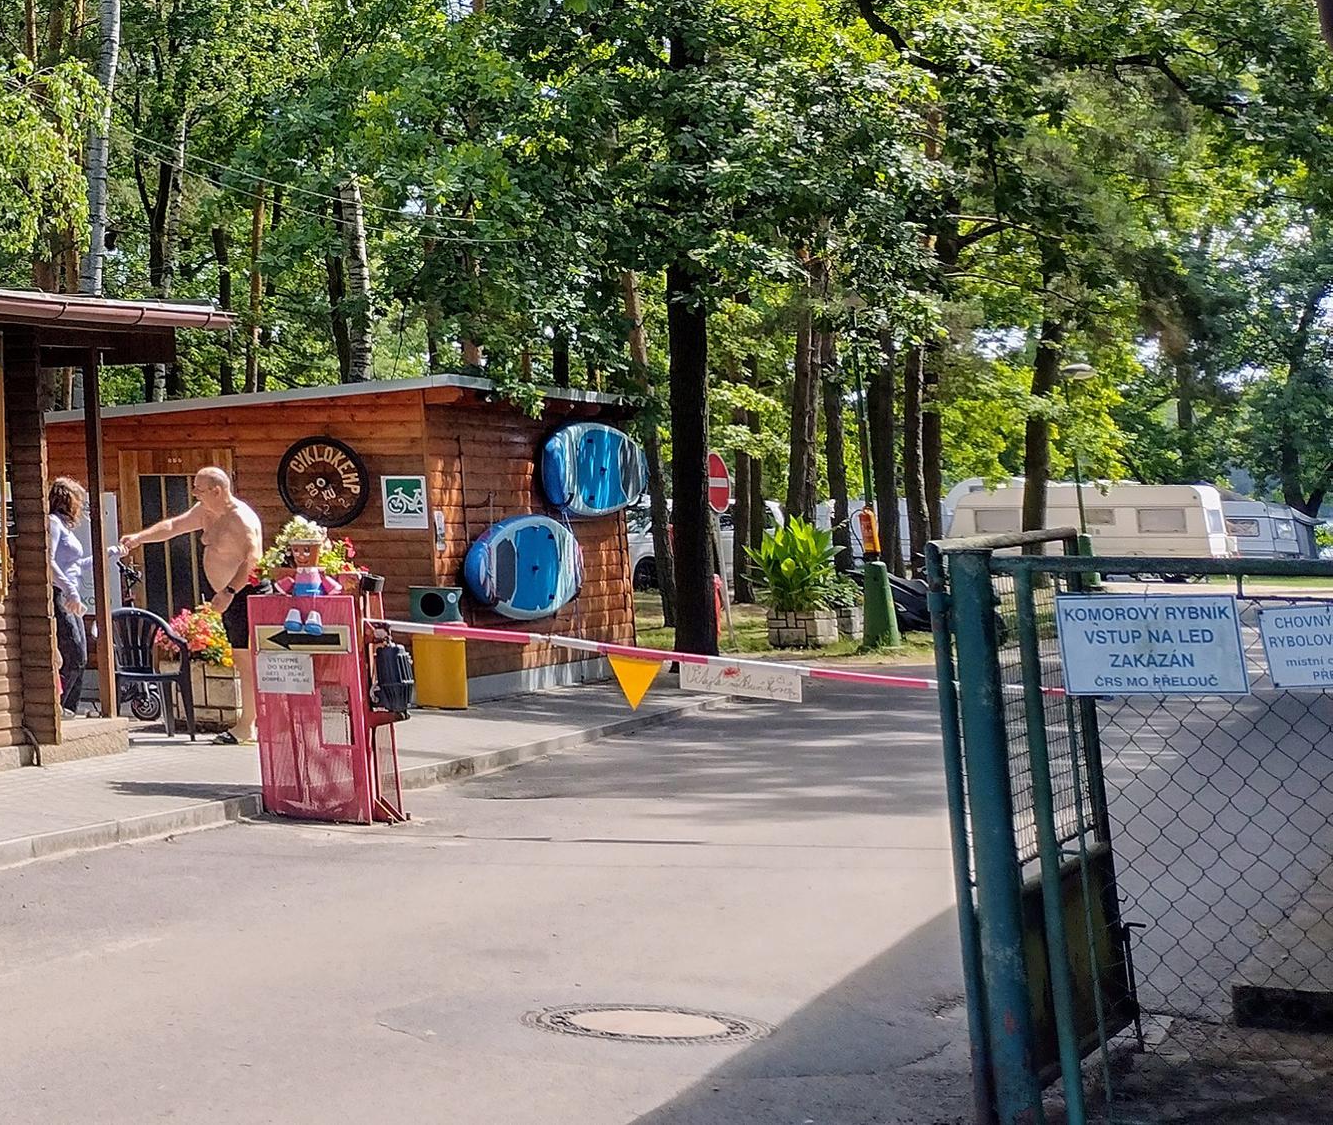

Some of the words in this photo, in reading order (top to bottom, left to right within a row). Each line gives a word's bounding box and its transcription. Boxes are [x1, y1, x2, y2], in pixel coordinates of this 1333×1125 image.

[290, 445, 360, 495] CYKLOKEMP
[1064, 603, 1159, 622] KOMOROVÝ
[1165, 601, 1231, 621] RYBNÍK
[1084, 627, 1142, 645] VSTUP
[1148, 628, 1175, 644] NA
[1179, 628, 1214, 644] LED
[1269, 634, 1333, 648] RYBOLOV
[1109, 649, 1195, 668] ZAKÁZÁN
[1286, 657, 1324, 667] místní
[1094, 674, 1122, 687] ČRS
[1127, 675, 1149, 687] MO
[1152, 674, 1219, 687] PŘELOUČ
[1313, 668, 1333, 680] PŘE
